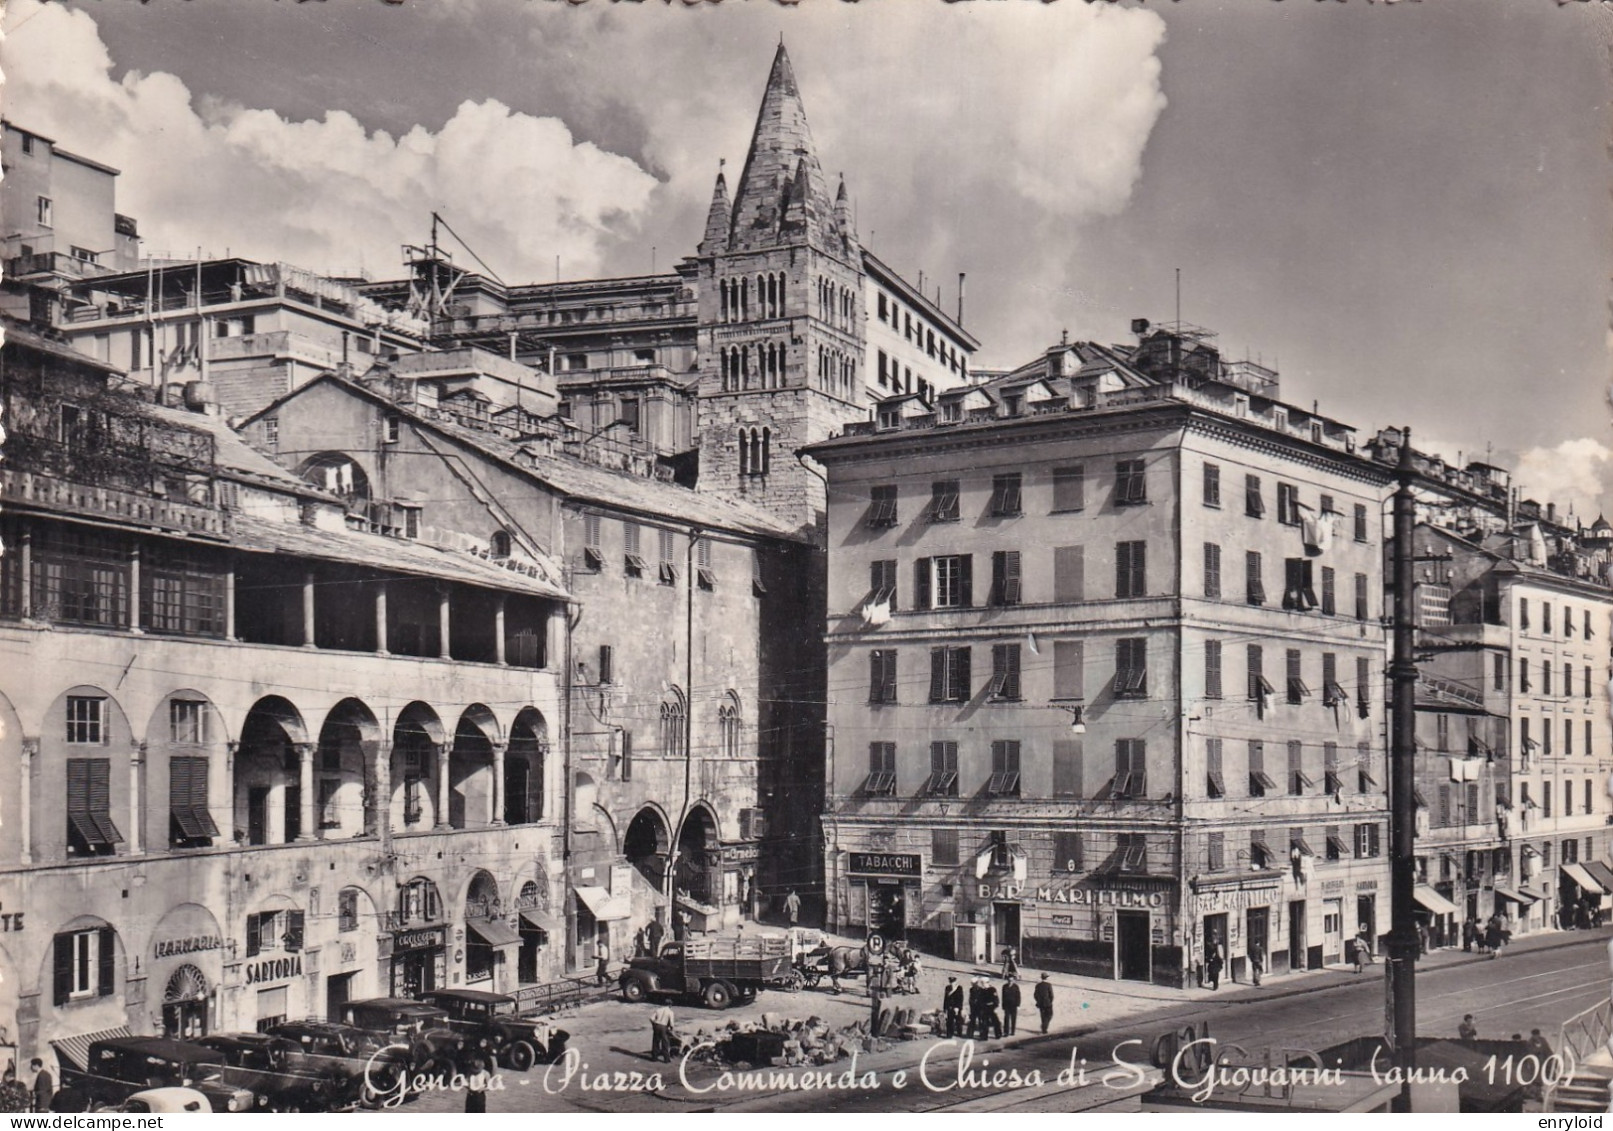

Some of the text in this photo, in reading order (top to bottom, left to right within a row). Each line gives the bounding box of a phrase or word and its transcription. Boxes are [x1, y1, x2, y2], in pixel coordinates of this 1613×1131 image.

[858, 855, 913, 869] TABACCHI
[979, 884, 1021, 900] BAR
[1037, 887, 1164, 908] MARITTIMO
[245, 956, 302, 984] SARTORIA
